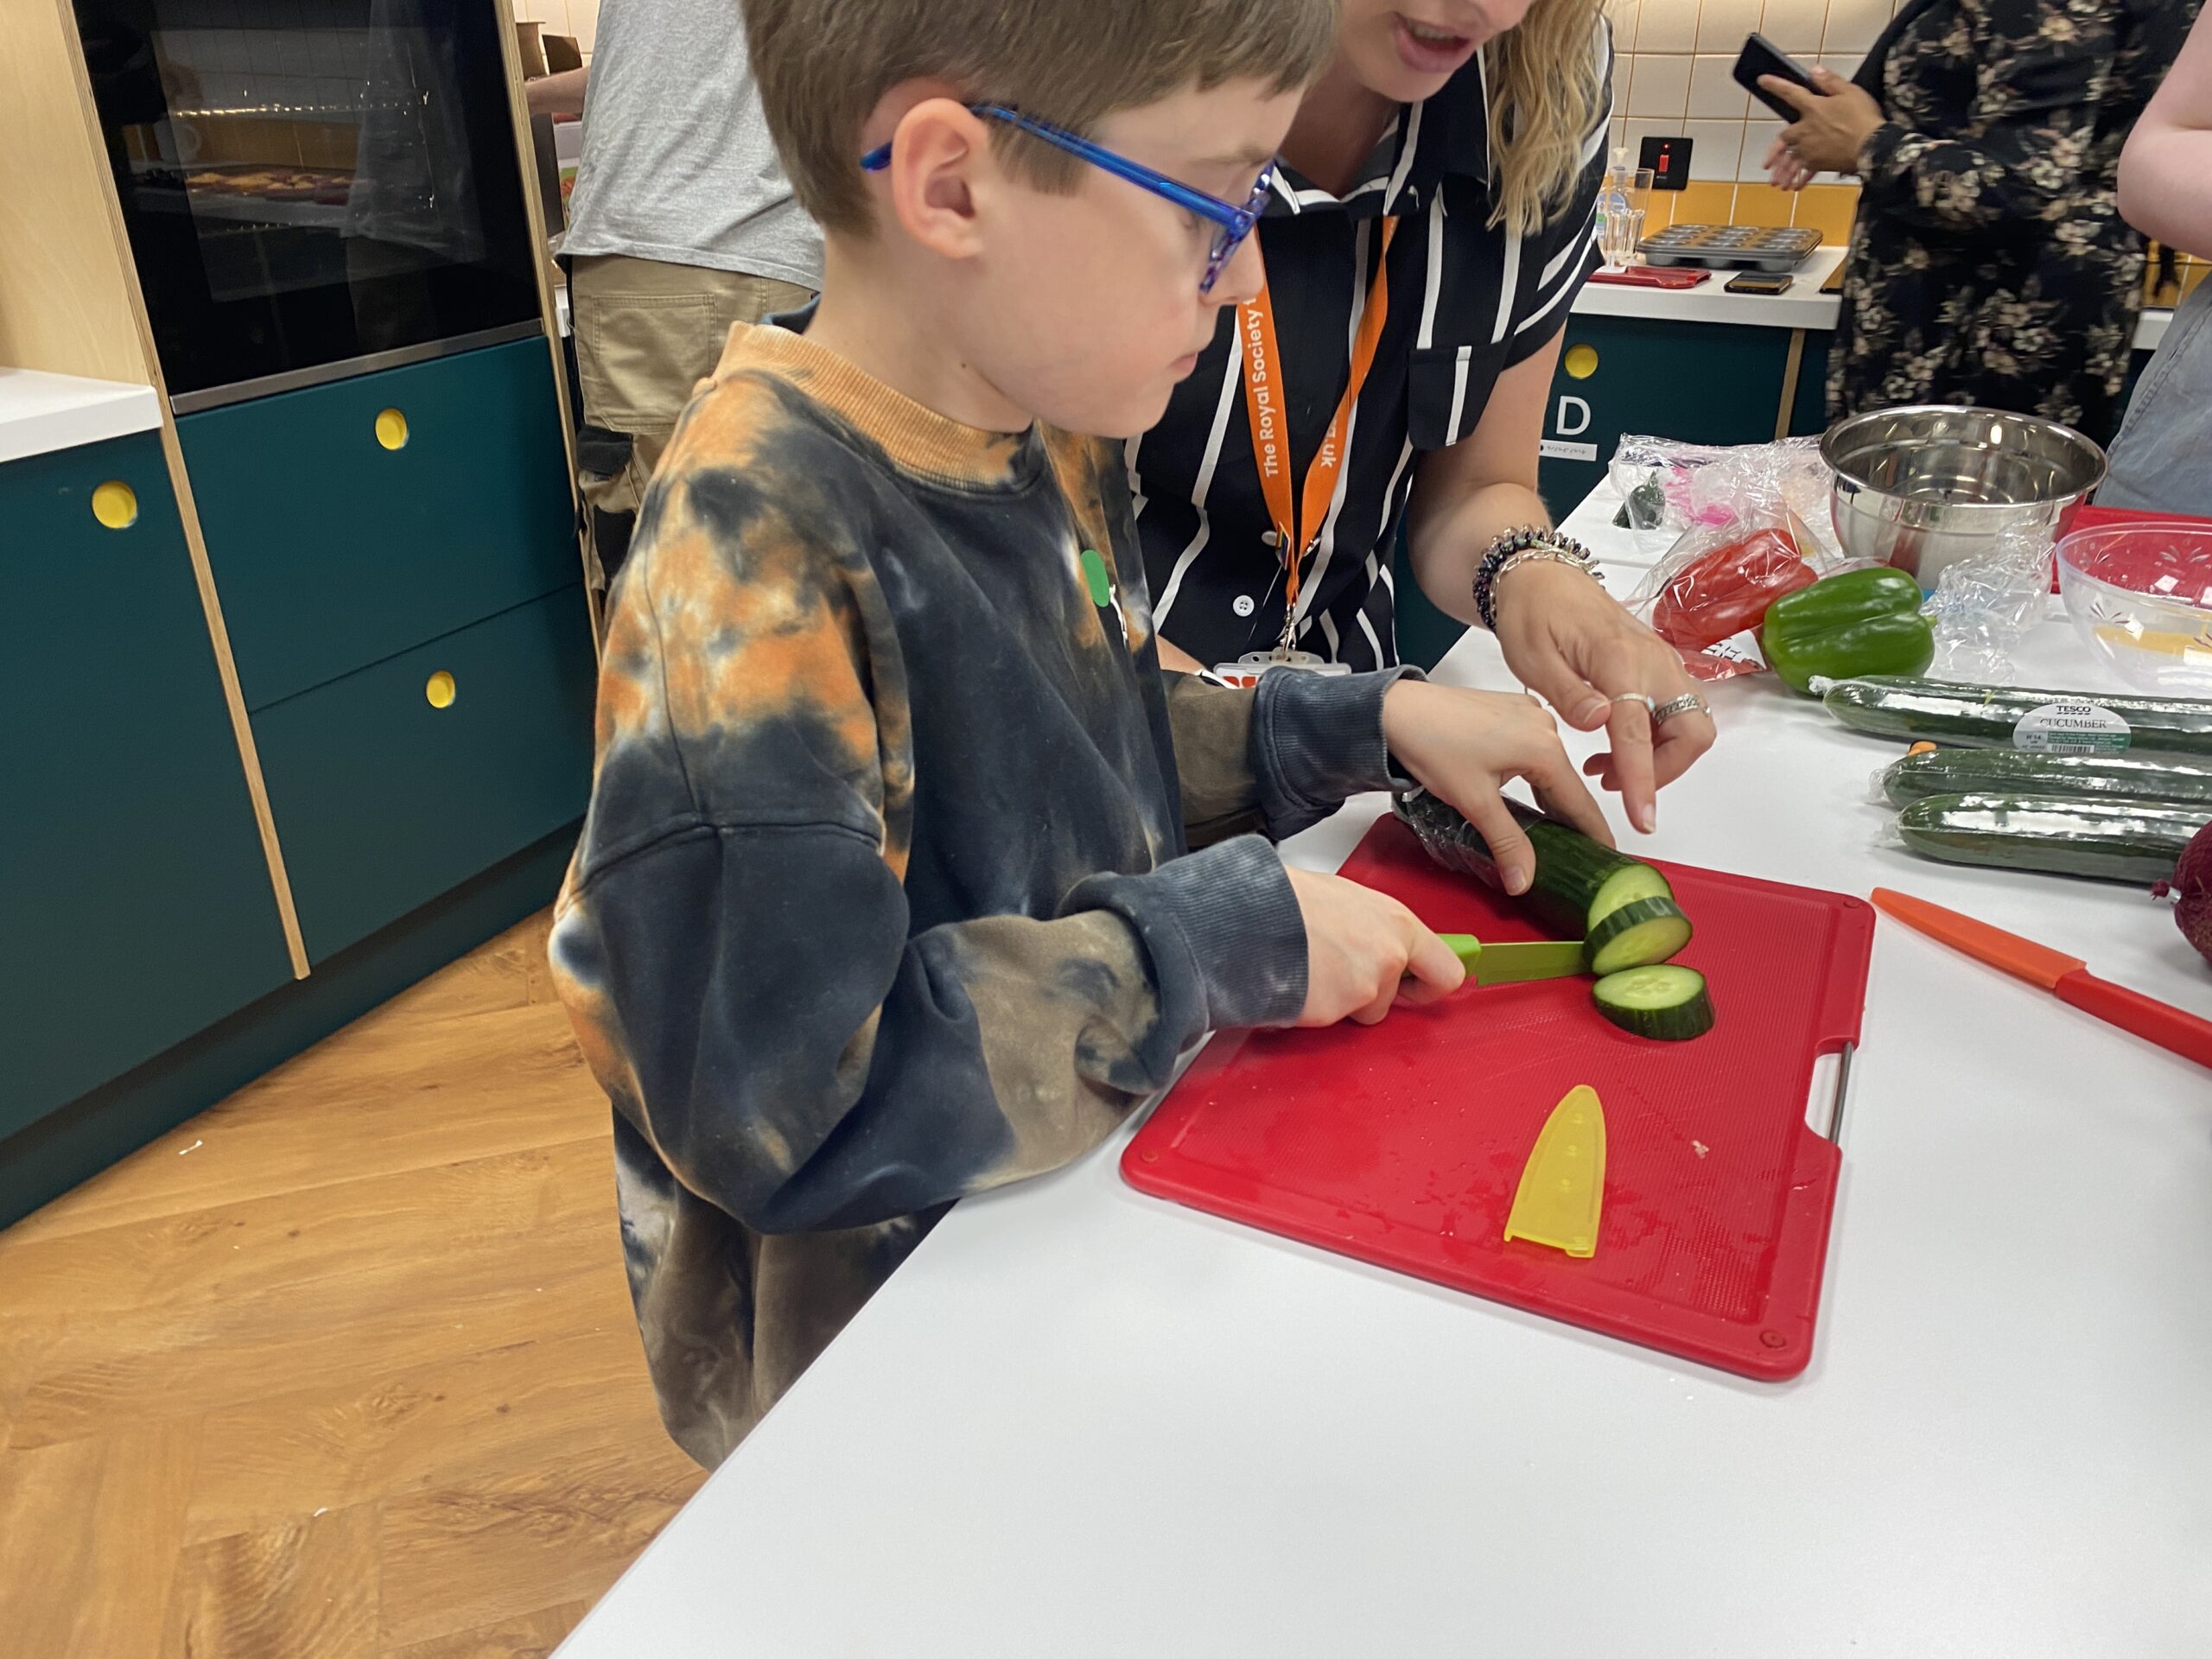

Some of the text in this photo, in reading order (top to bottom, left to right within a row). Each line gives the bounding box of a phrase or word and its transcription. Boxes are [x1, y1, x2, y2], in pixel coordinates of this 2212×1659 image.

[1247, 308, 1266, 383] Society
[1253, 385, 1276, 440] Royal
[1556, 395, 1591, 435] D
[1263, 445, 1279, 477] The
[2039, 718, 2107, 729] CUCUMBER
